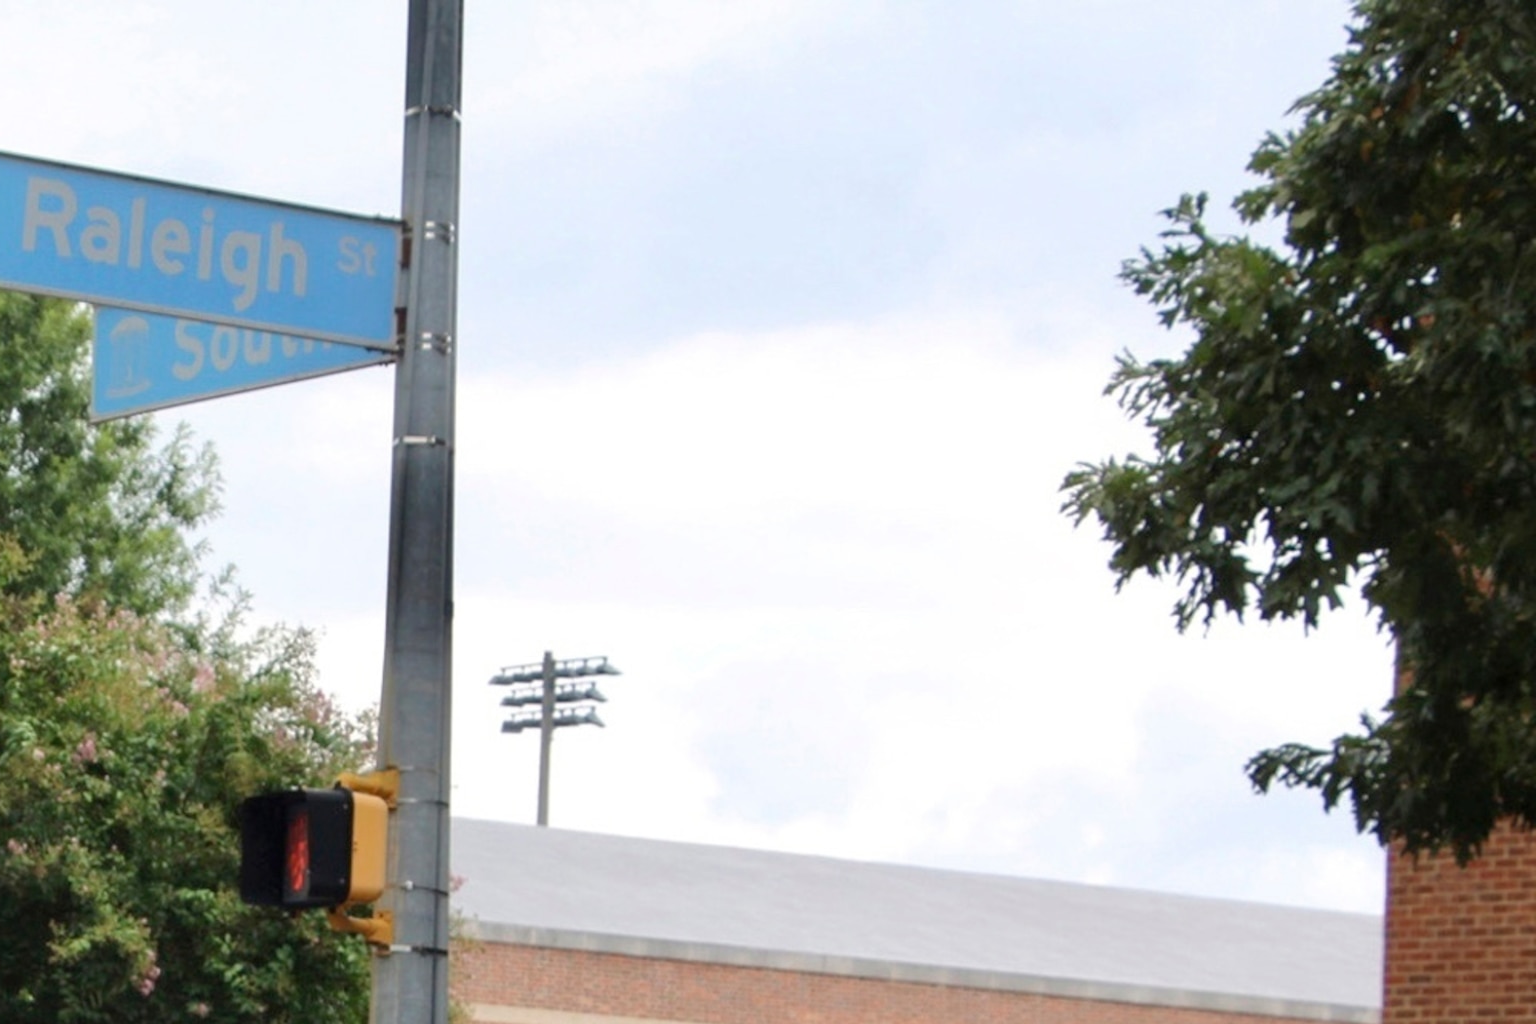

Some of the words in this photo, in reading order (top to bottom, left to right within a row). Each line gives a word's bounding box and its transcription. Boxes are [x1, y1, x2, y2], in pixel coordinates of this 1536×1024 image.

[21, 175, 308, 312] Raleigh
[337, 236, 377, 277] St
[172, 319, 333, 381] Sou
